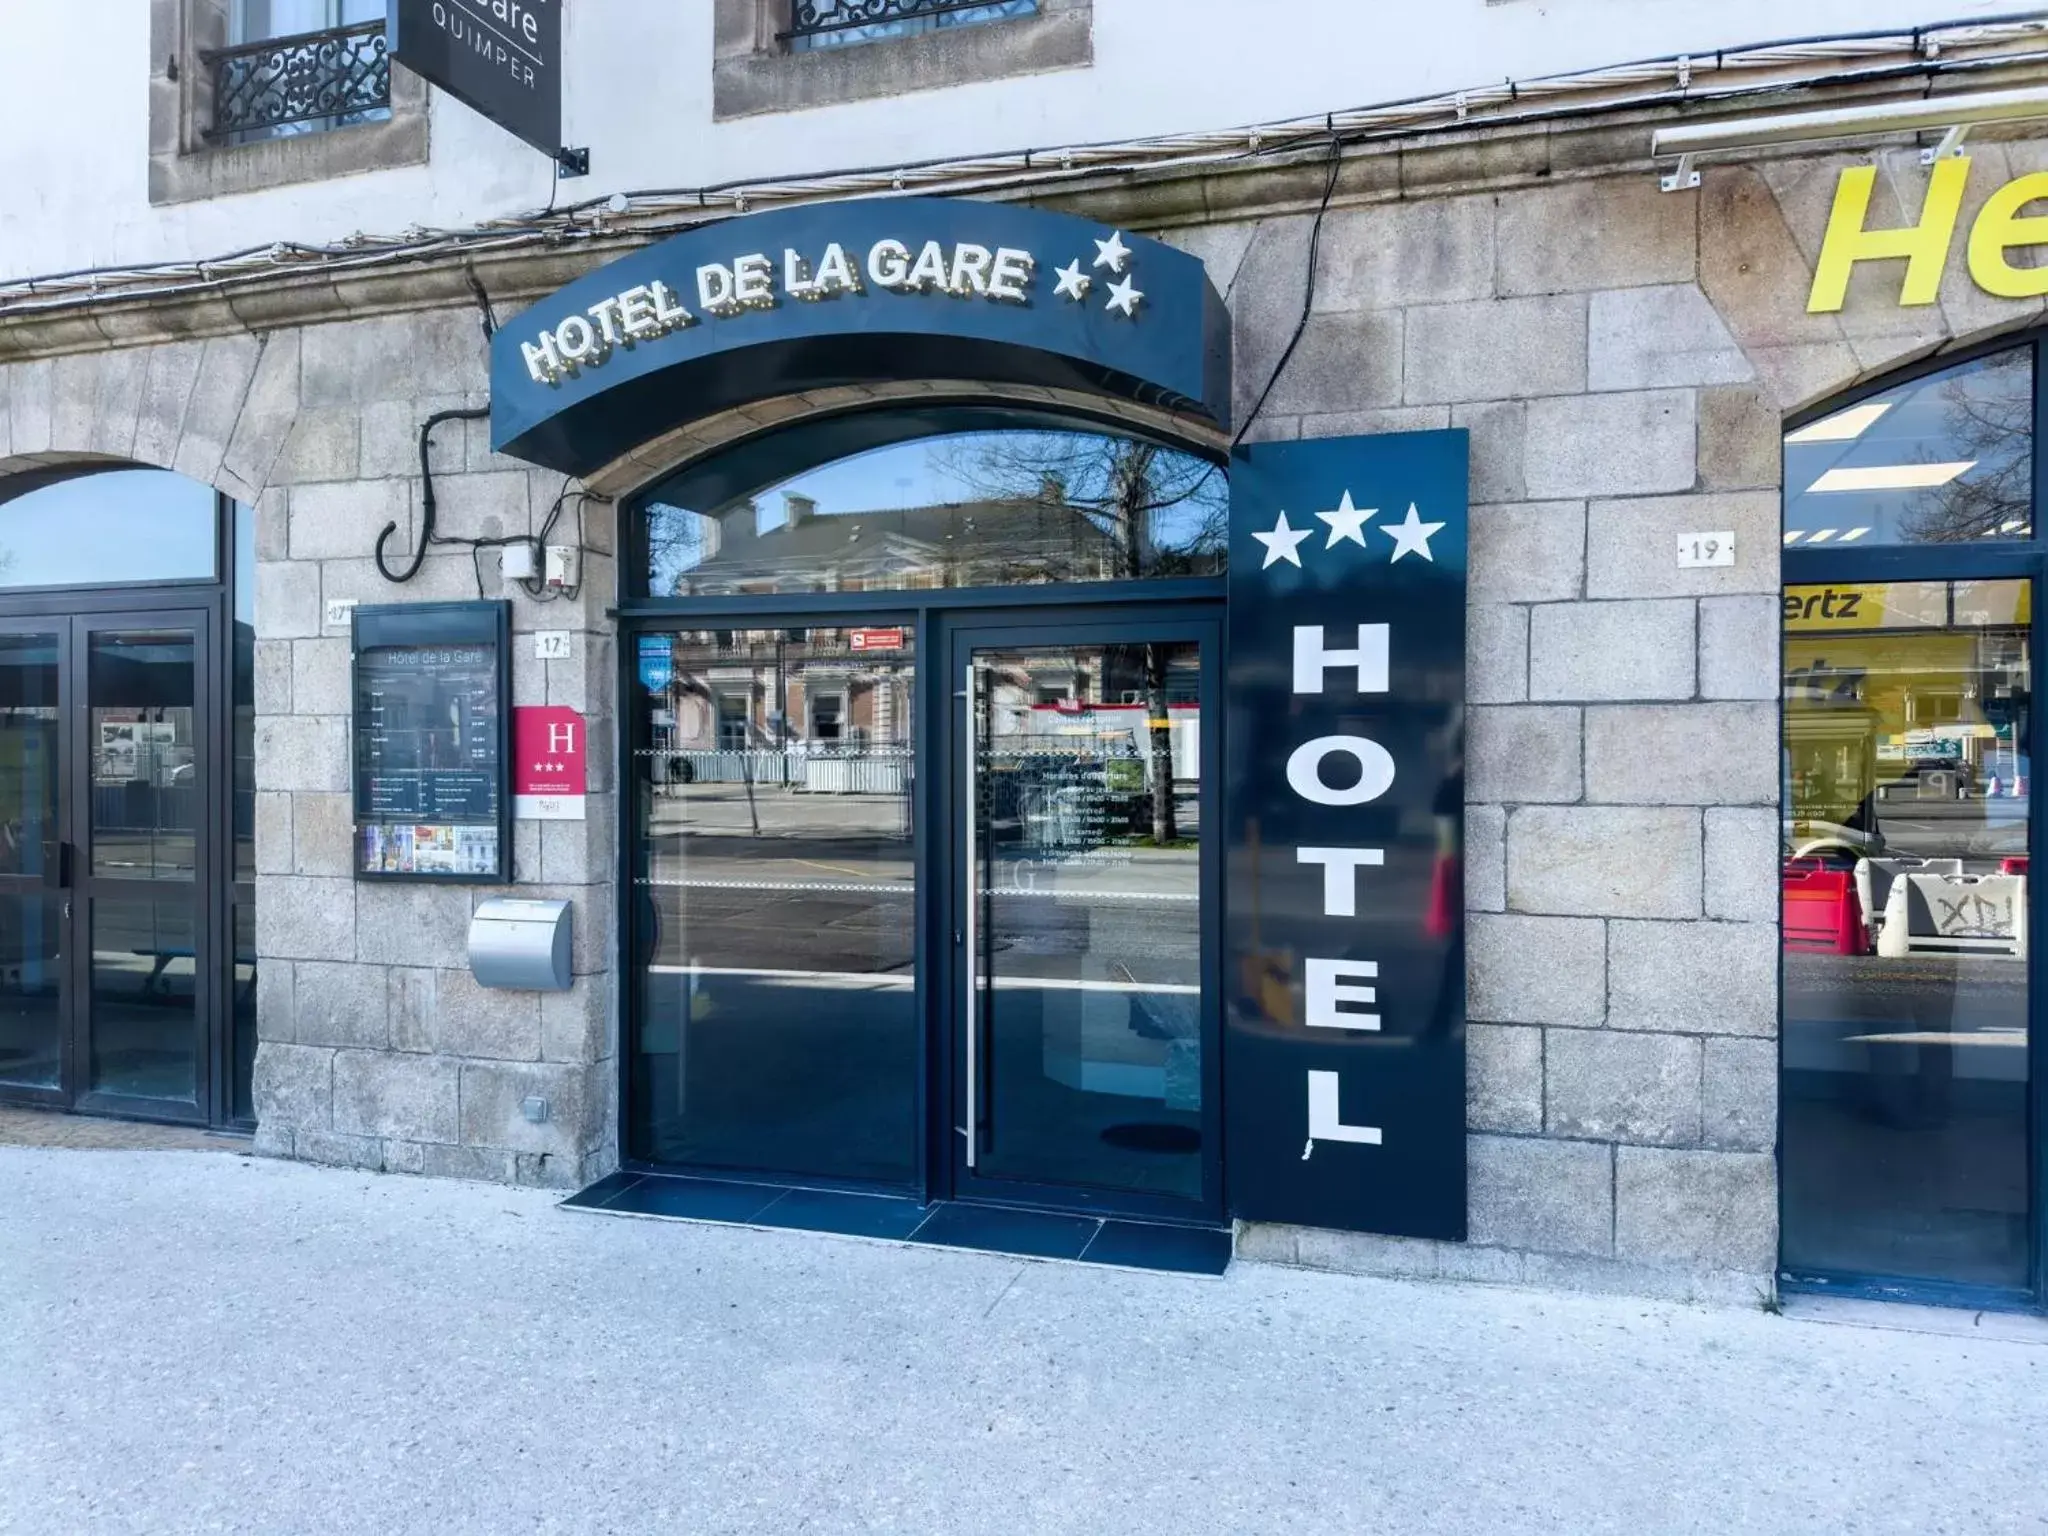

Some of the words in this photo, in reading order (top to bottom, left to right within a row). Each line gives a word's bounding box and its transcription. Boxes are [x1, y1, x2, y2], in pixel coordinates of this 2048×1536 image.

[432, 3, 536, 90] QUIMPER
[476, 0, 538, 44] are
[1806, 155, 2048, 314] He
[520, 279, 694, 384] HOTEL
[696, 252, 775, 311] DE
[784, 242, 859, 294] LA
[867, 238, 1036, 302] GARE
[1691, 539, 1720, 560] 19
[544, 637, 561, 653] 17
[547, 723, 576, 753] H
[1286, 622, 1396, 1146] HOTEL
